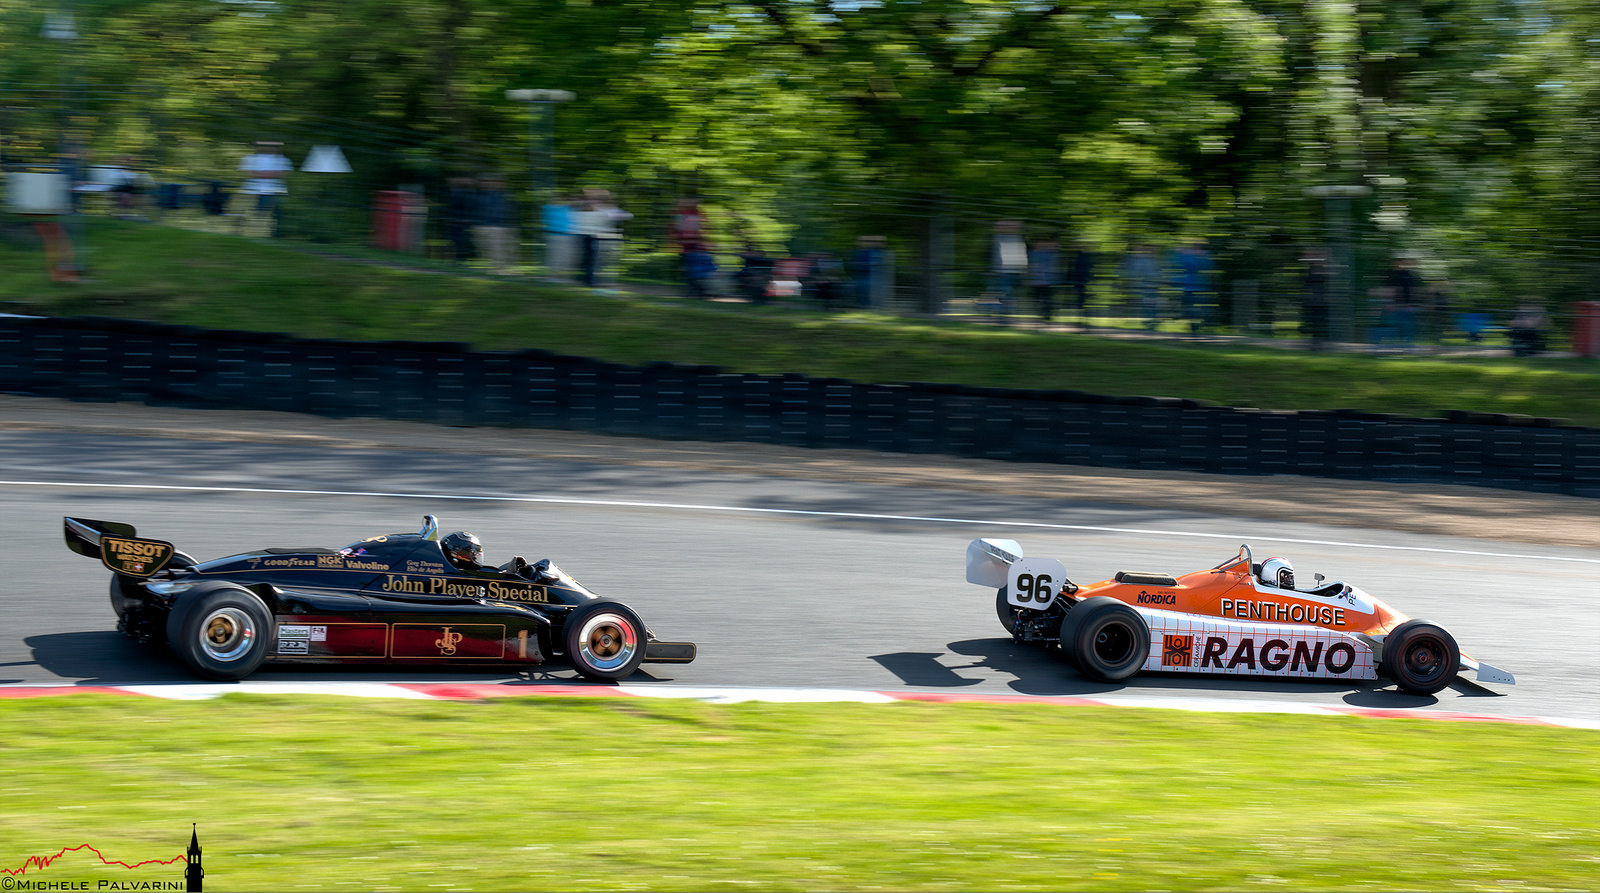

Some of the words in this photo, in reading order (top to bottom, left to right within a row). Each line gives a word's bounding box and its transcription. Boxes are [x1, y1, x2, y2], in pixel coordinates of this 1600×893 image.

[108, 540, 166, 558] TISSOT
[318, 555, 343, 565] NGK
[264, 557, 315, 567] GOODYEAR
[346, 560, 390, 570] Valvoline
[382, 574, 425, 594] John
[488, 581, 549, 603] Special
[1016, 573, 1052, 603] 96
[1137, 591, 1176, 606] NORDICA
[1220, 597, 1346, 626] PENTHOUSE
[518, 629, 529, 659] 1
[1201, 636, 1356, 674] RAGNO
